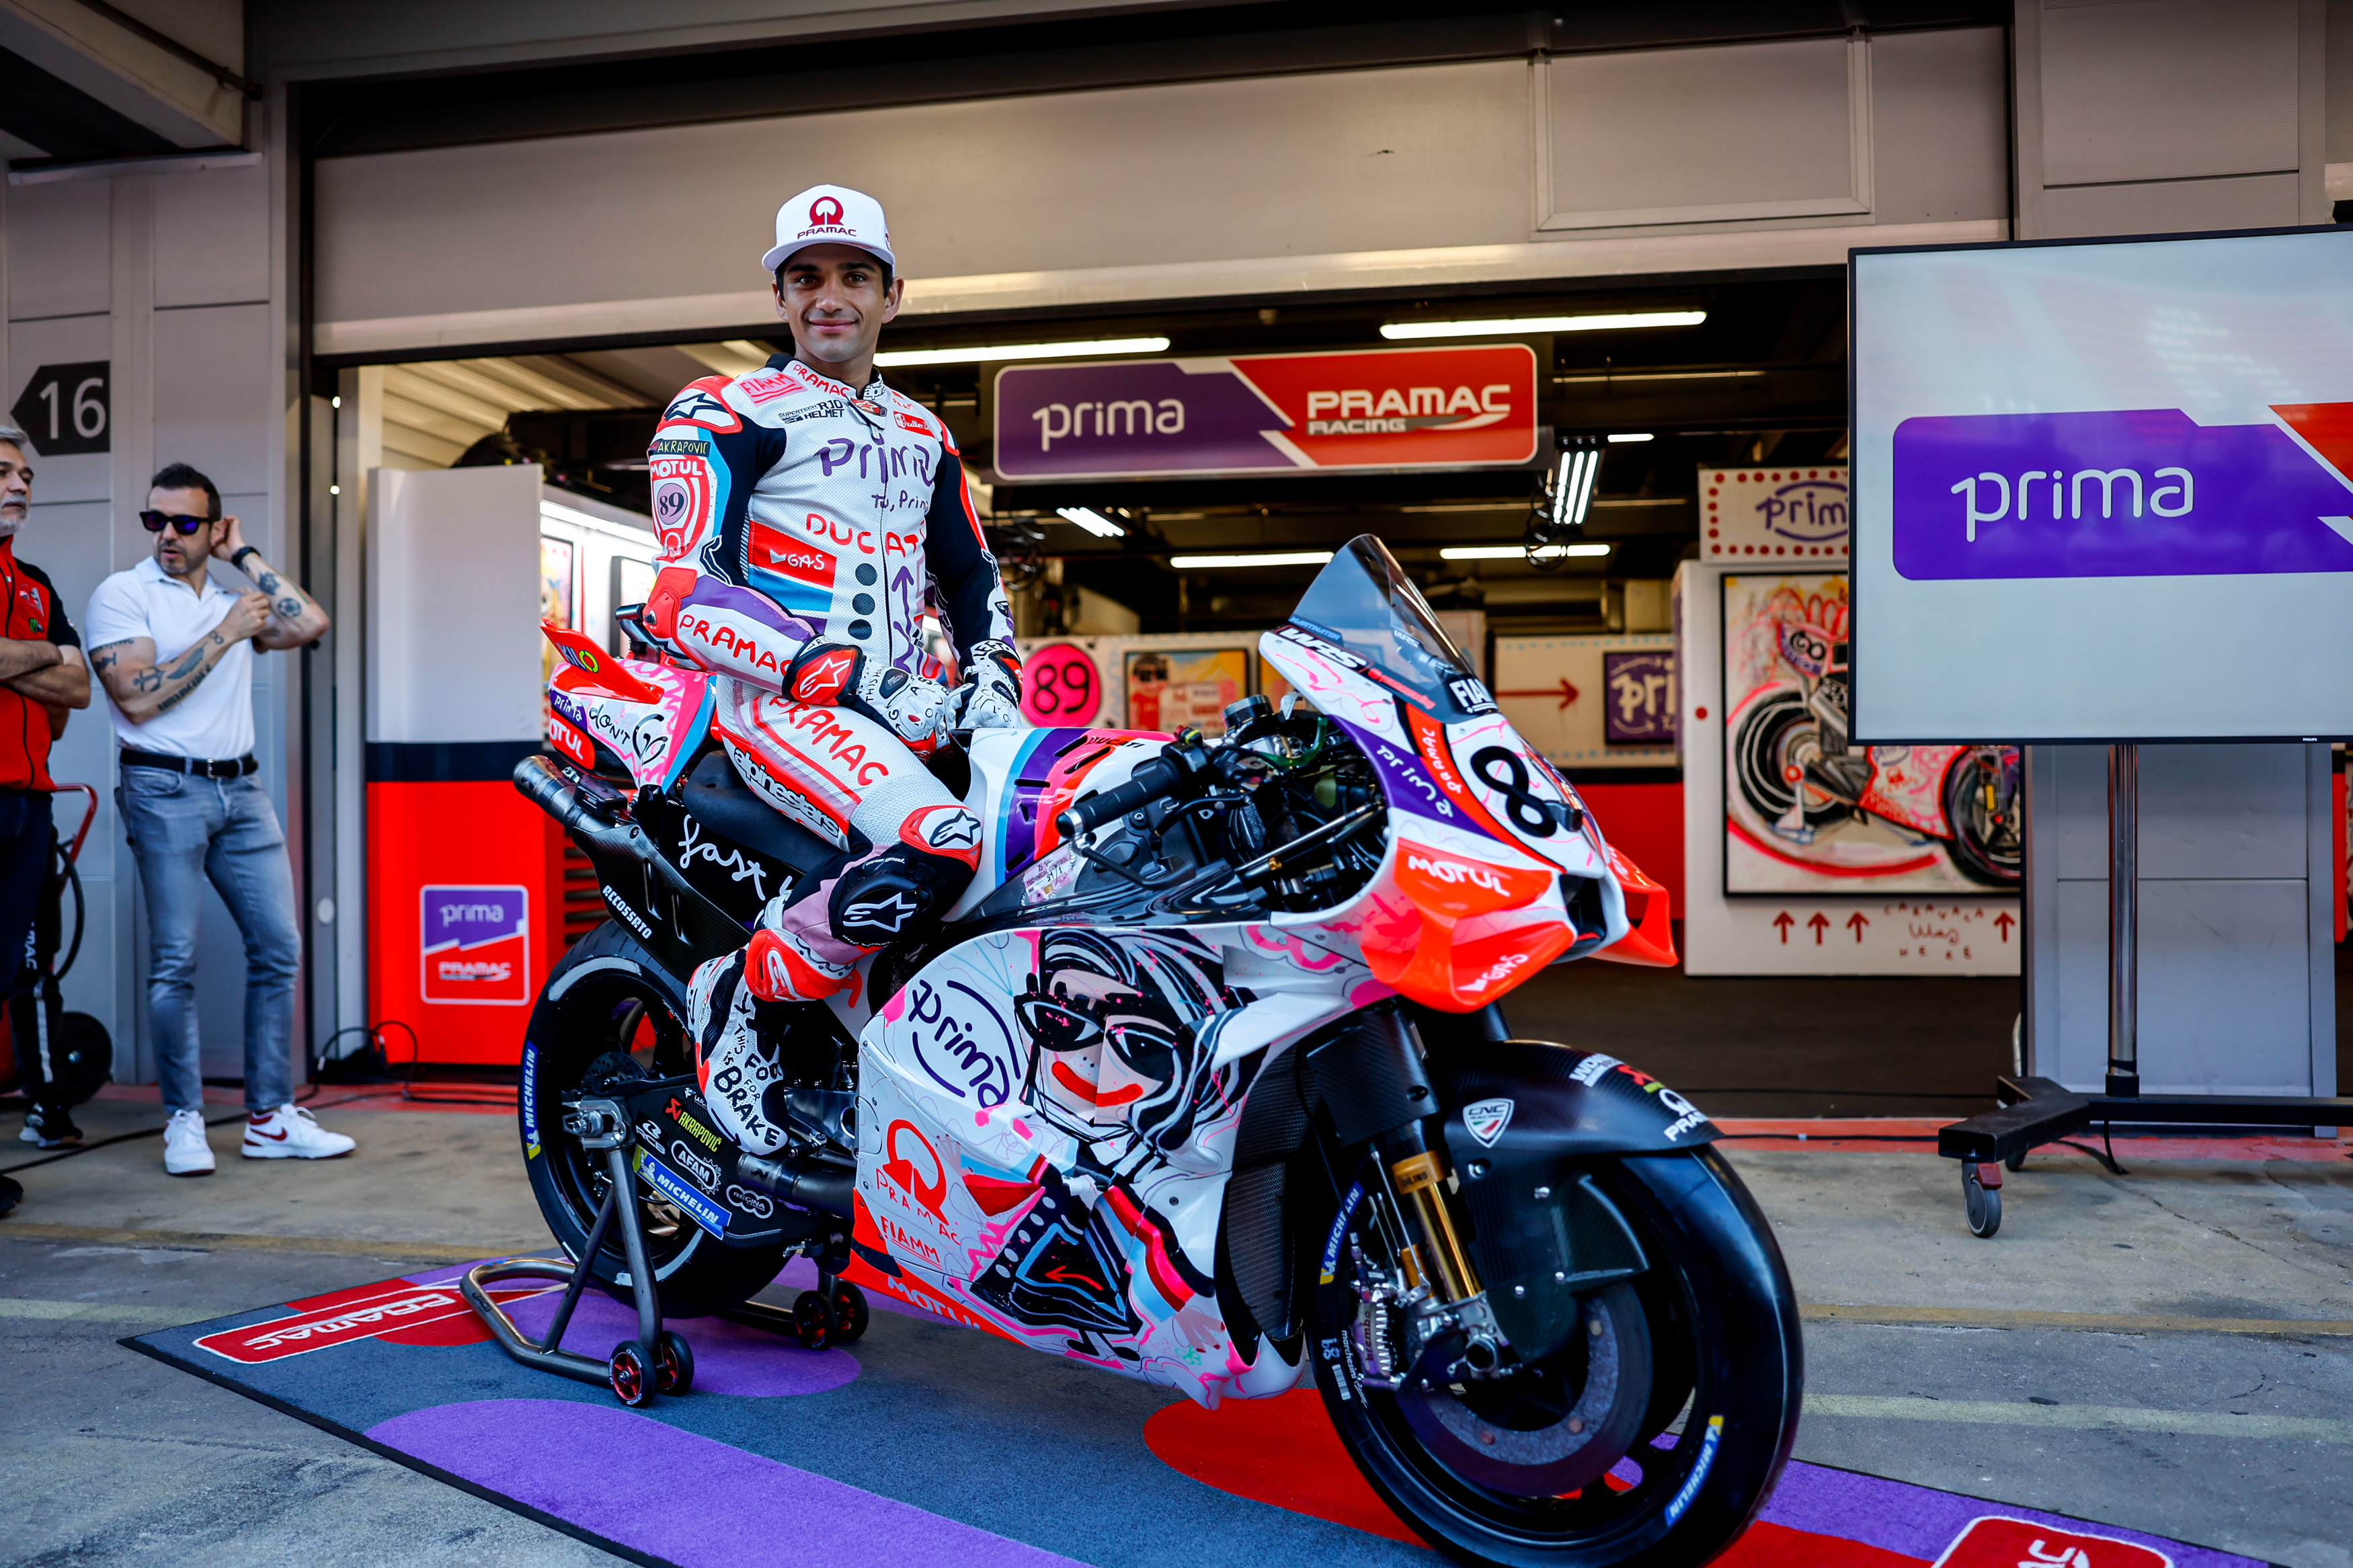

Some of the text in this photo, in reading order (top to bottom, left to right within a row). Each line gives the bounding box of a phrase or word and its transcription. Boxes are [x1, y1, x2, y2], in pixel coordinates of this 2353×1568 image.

[797, 226, 856, 239] PRAMAC
[740, 373, 795, 395] FIAMM
[793, 364, 850, 397] PRAMAC
[39, 377, 107, 440] 16
[804, 408, 845, 419] HELMET
[1306, 384, 1511, 419] PRAMAC
[1031, 398, 1185, 453] prima
[1306, 418, 1407, 436] RACING
[651, 460, 703, 478] MOTUL
[660, 492, 684, 518] 89
[1755, 490, 1848, 531] prim
[1950, 466, 2194, 543] prima
[787, 552, 825, 571] GAS
[679, 614, 793, 677] PRAMAC
[973, 641, 1004, 657] LEFT
[1279, 627, 1367, 668] WRS
[1033, 661, 1090, 714] 89
[1449, 678, 1494, 708] FIA
[554, 694, 583, 723] prima
[549, 718, 584, 761] OTUL
[768, 695, 889, 786] PRAMAC
[1086, 735, 1146, 749] DUCATI
[1421, 727, 1462, 794] PRAMAC
[733, 745, 839, 839] alpinestars
[1376, 745, 1453, 819] prima
[1026, 856, 1069, 886] TECHNICAL CONTROL
[1408, 854, 1511, 897] MOTUL
[439, 903, 505, 928] prima
[602, 884, 652, 940] ACCOSSATO
[1481, 953, 1529, 981] GAS
[733, 1023, 746, 1055] THIS
[908, 979, 1010, 1108] prima
[524, 1048, 536, 1128] MICHELIN
[713, 1065, 781, 1147] BRAKE
[744, 1079, 760, 1102] FOR
[1468, 1104, 1506, 1116] CNC
[678, 1150, 711, 1183] AFAM
[657, 1173, 720, 1224] MICHELIN
[733, 1192, 765, 1209] REGINA
[876, 1167, 961, 1246] PRAMAC
[880, 1215, 941, 1264] FIAMM
[887, 1276, 980, 1329] MOTU
[1341, 1329, 1358, 1379] marchesini
[1360, 1311, 1374, 1362] brembo
[1669, 1443, 1713, 1518] MICHELIN
